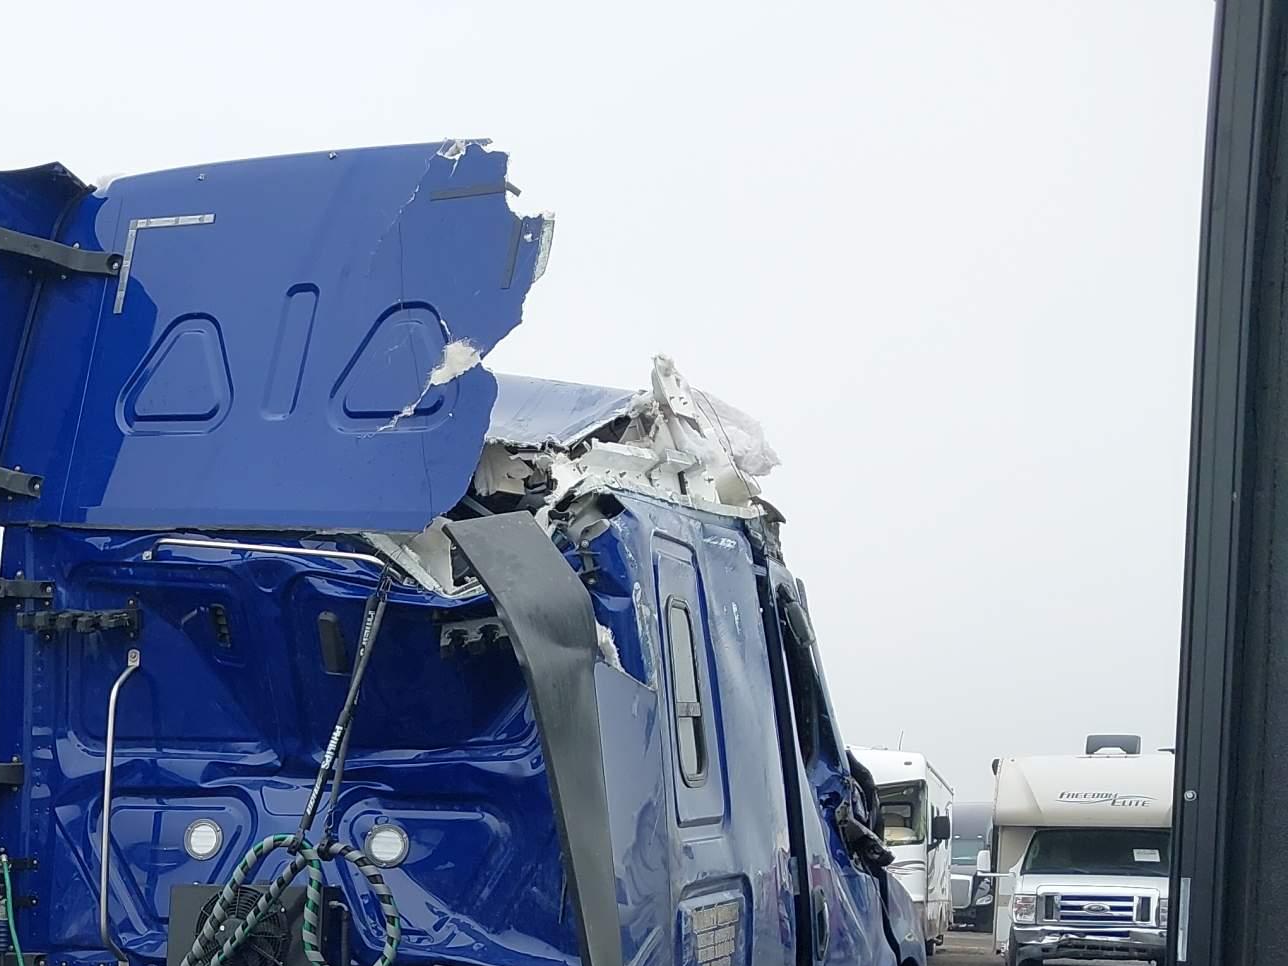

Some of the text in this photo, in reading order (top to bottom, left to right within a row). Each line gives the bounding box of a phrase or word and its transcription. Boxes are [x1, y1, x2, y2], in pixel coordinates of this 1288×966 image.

[320, 725, 343, 770] PHILLIPS
[1058, 791, 1119, 800] FREEDOM
[1110, 799, 1152, 807] ELITE
